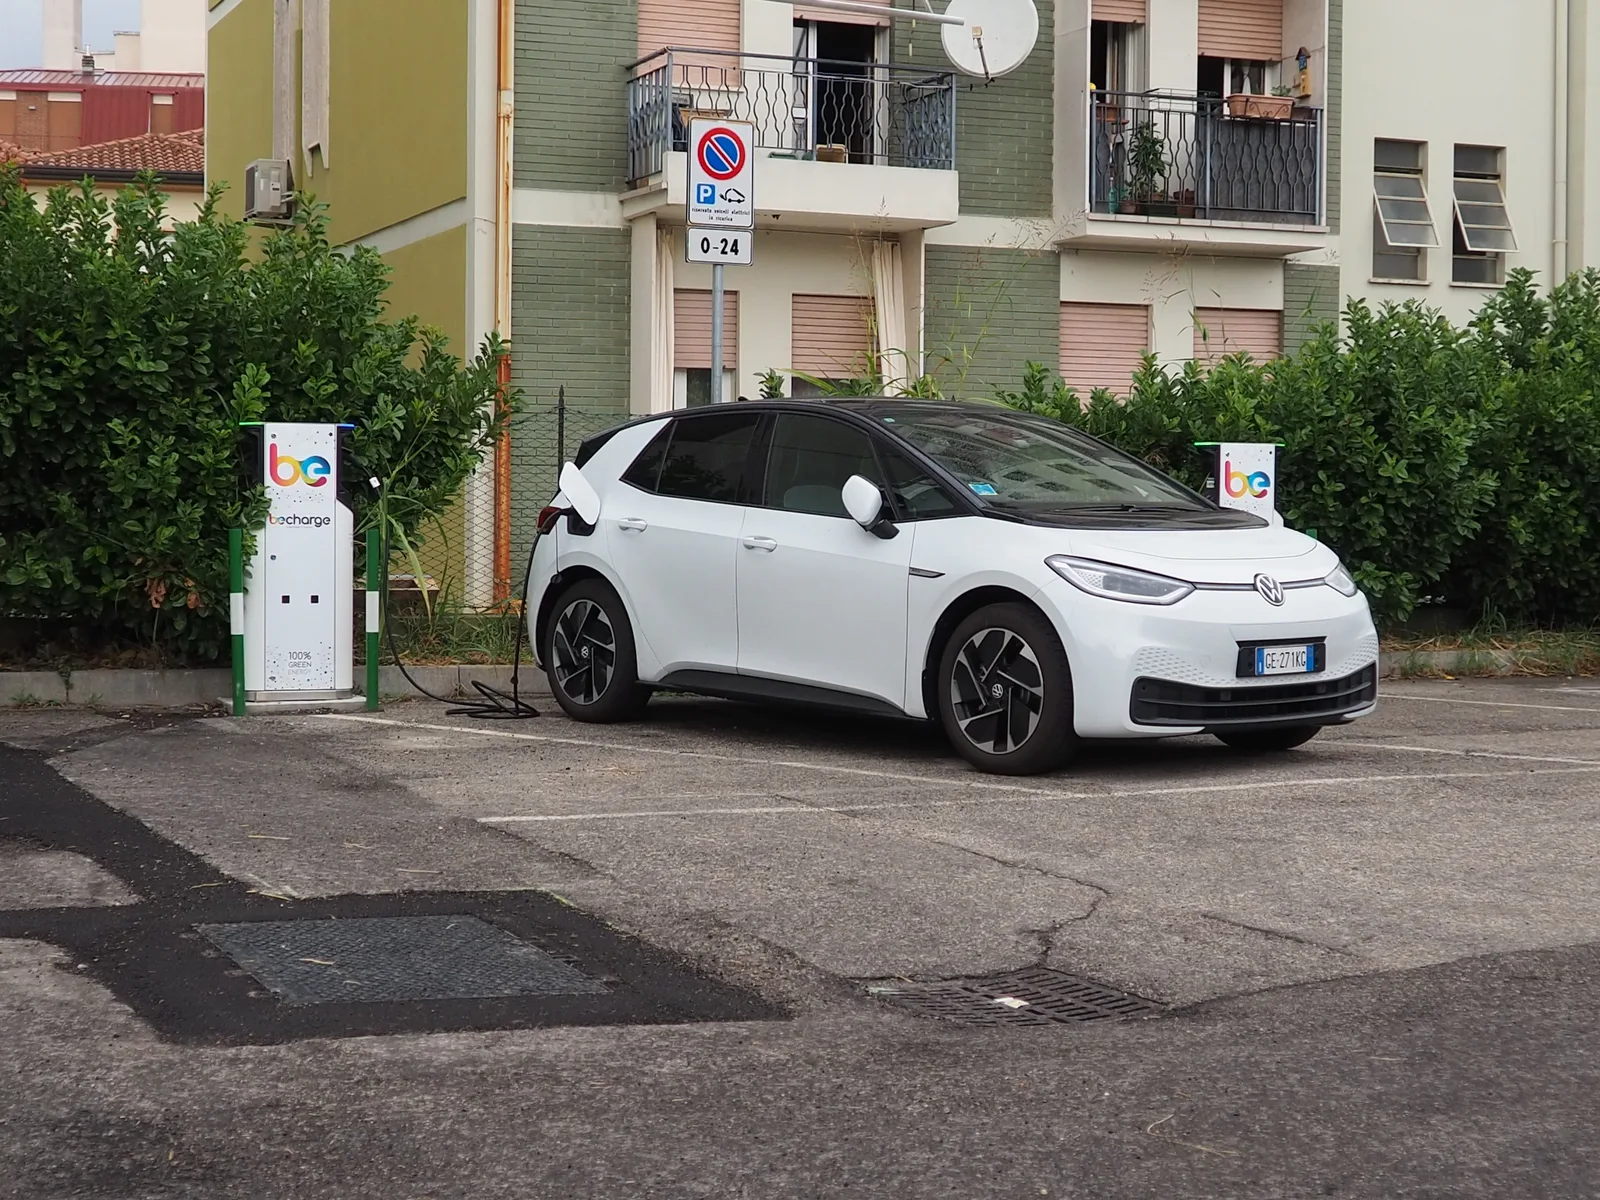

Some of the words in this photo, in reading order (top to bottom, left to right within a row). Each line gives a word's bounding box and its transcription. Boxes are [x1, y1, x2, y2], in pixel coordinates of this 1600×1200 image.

[700, 185, 712, 202] P
[701, 237, 739, 255] 0-24
[270, 443, 331, 487] be
[1225, 460, 1271, 499] be
[269, 513, 331, 527] becharge
[288, 651, 312, 660] 100%
